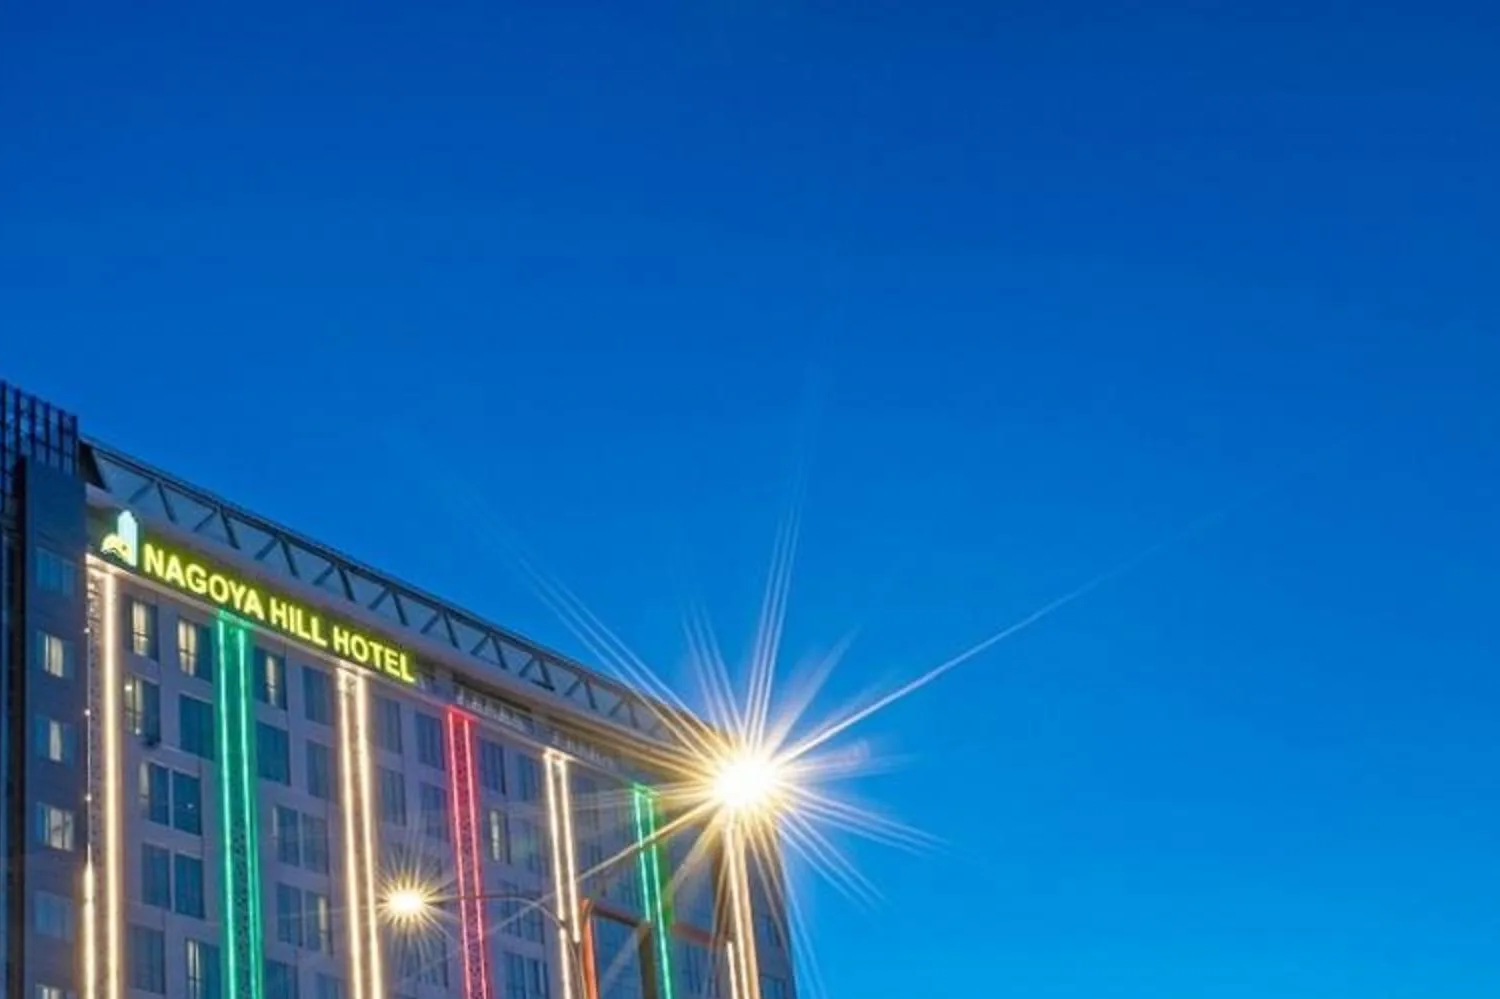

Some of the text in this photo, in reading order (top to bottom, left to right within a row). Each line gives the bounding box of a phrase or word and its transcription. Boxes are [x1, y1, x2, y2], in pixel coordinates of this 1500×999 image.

[144, 543, 416, 683] NAGOYA HILL HOTEL
